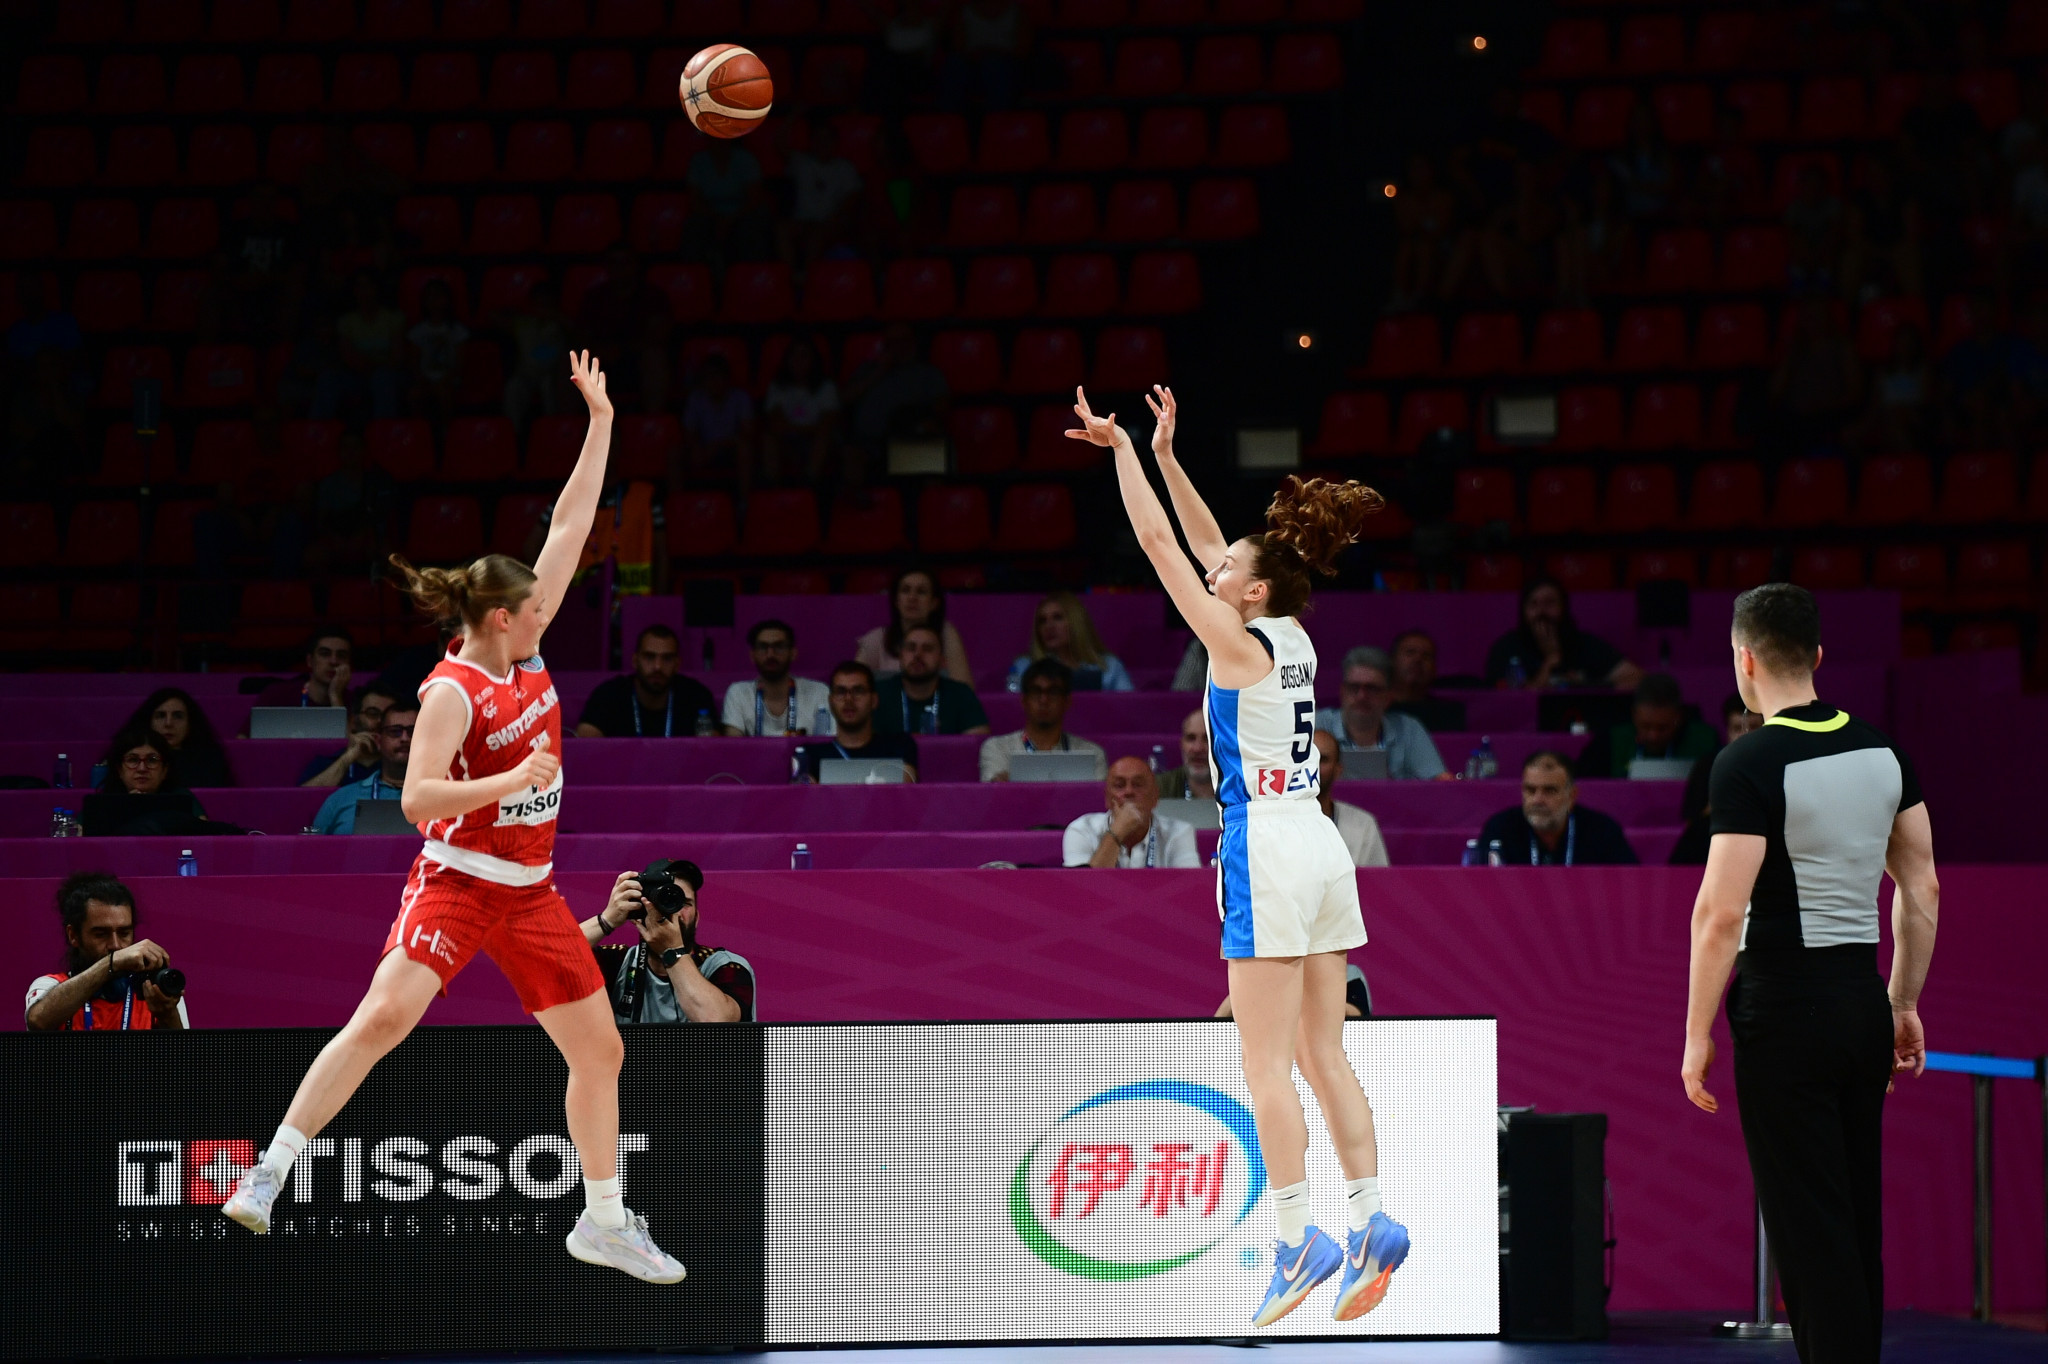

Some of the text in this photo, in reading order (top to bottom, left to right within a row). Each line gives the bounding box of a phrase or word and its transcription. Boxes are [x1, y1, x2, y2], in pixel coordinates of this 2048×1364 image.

[1290, 700, 1314, 764] 5
[500, 787, 562, 819] TISSO
[1286, 767, 1320, 792] EK
[293, 1134, 650, 1204] TISSOT
[1046, 1140, 1229, 1220] 伊利
[117, 1219, 227, 1242] SWISS
[253, 1215, 420, 1239] ATCHES
